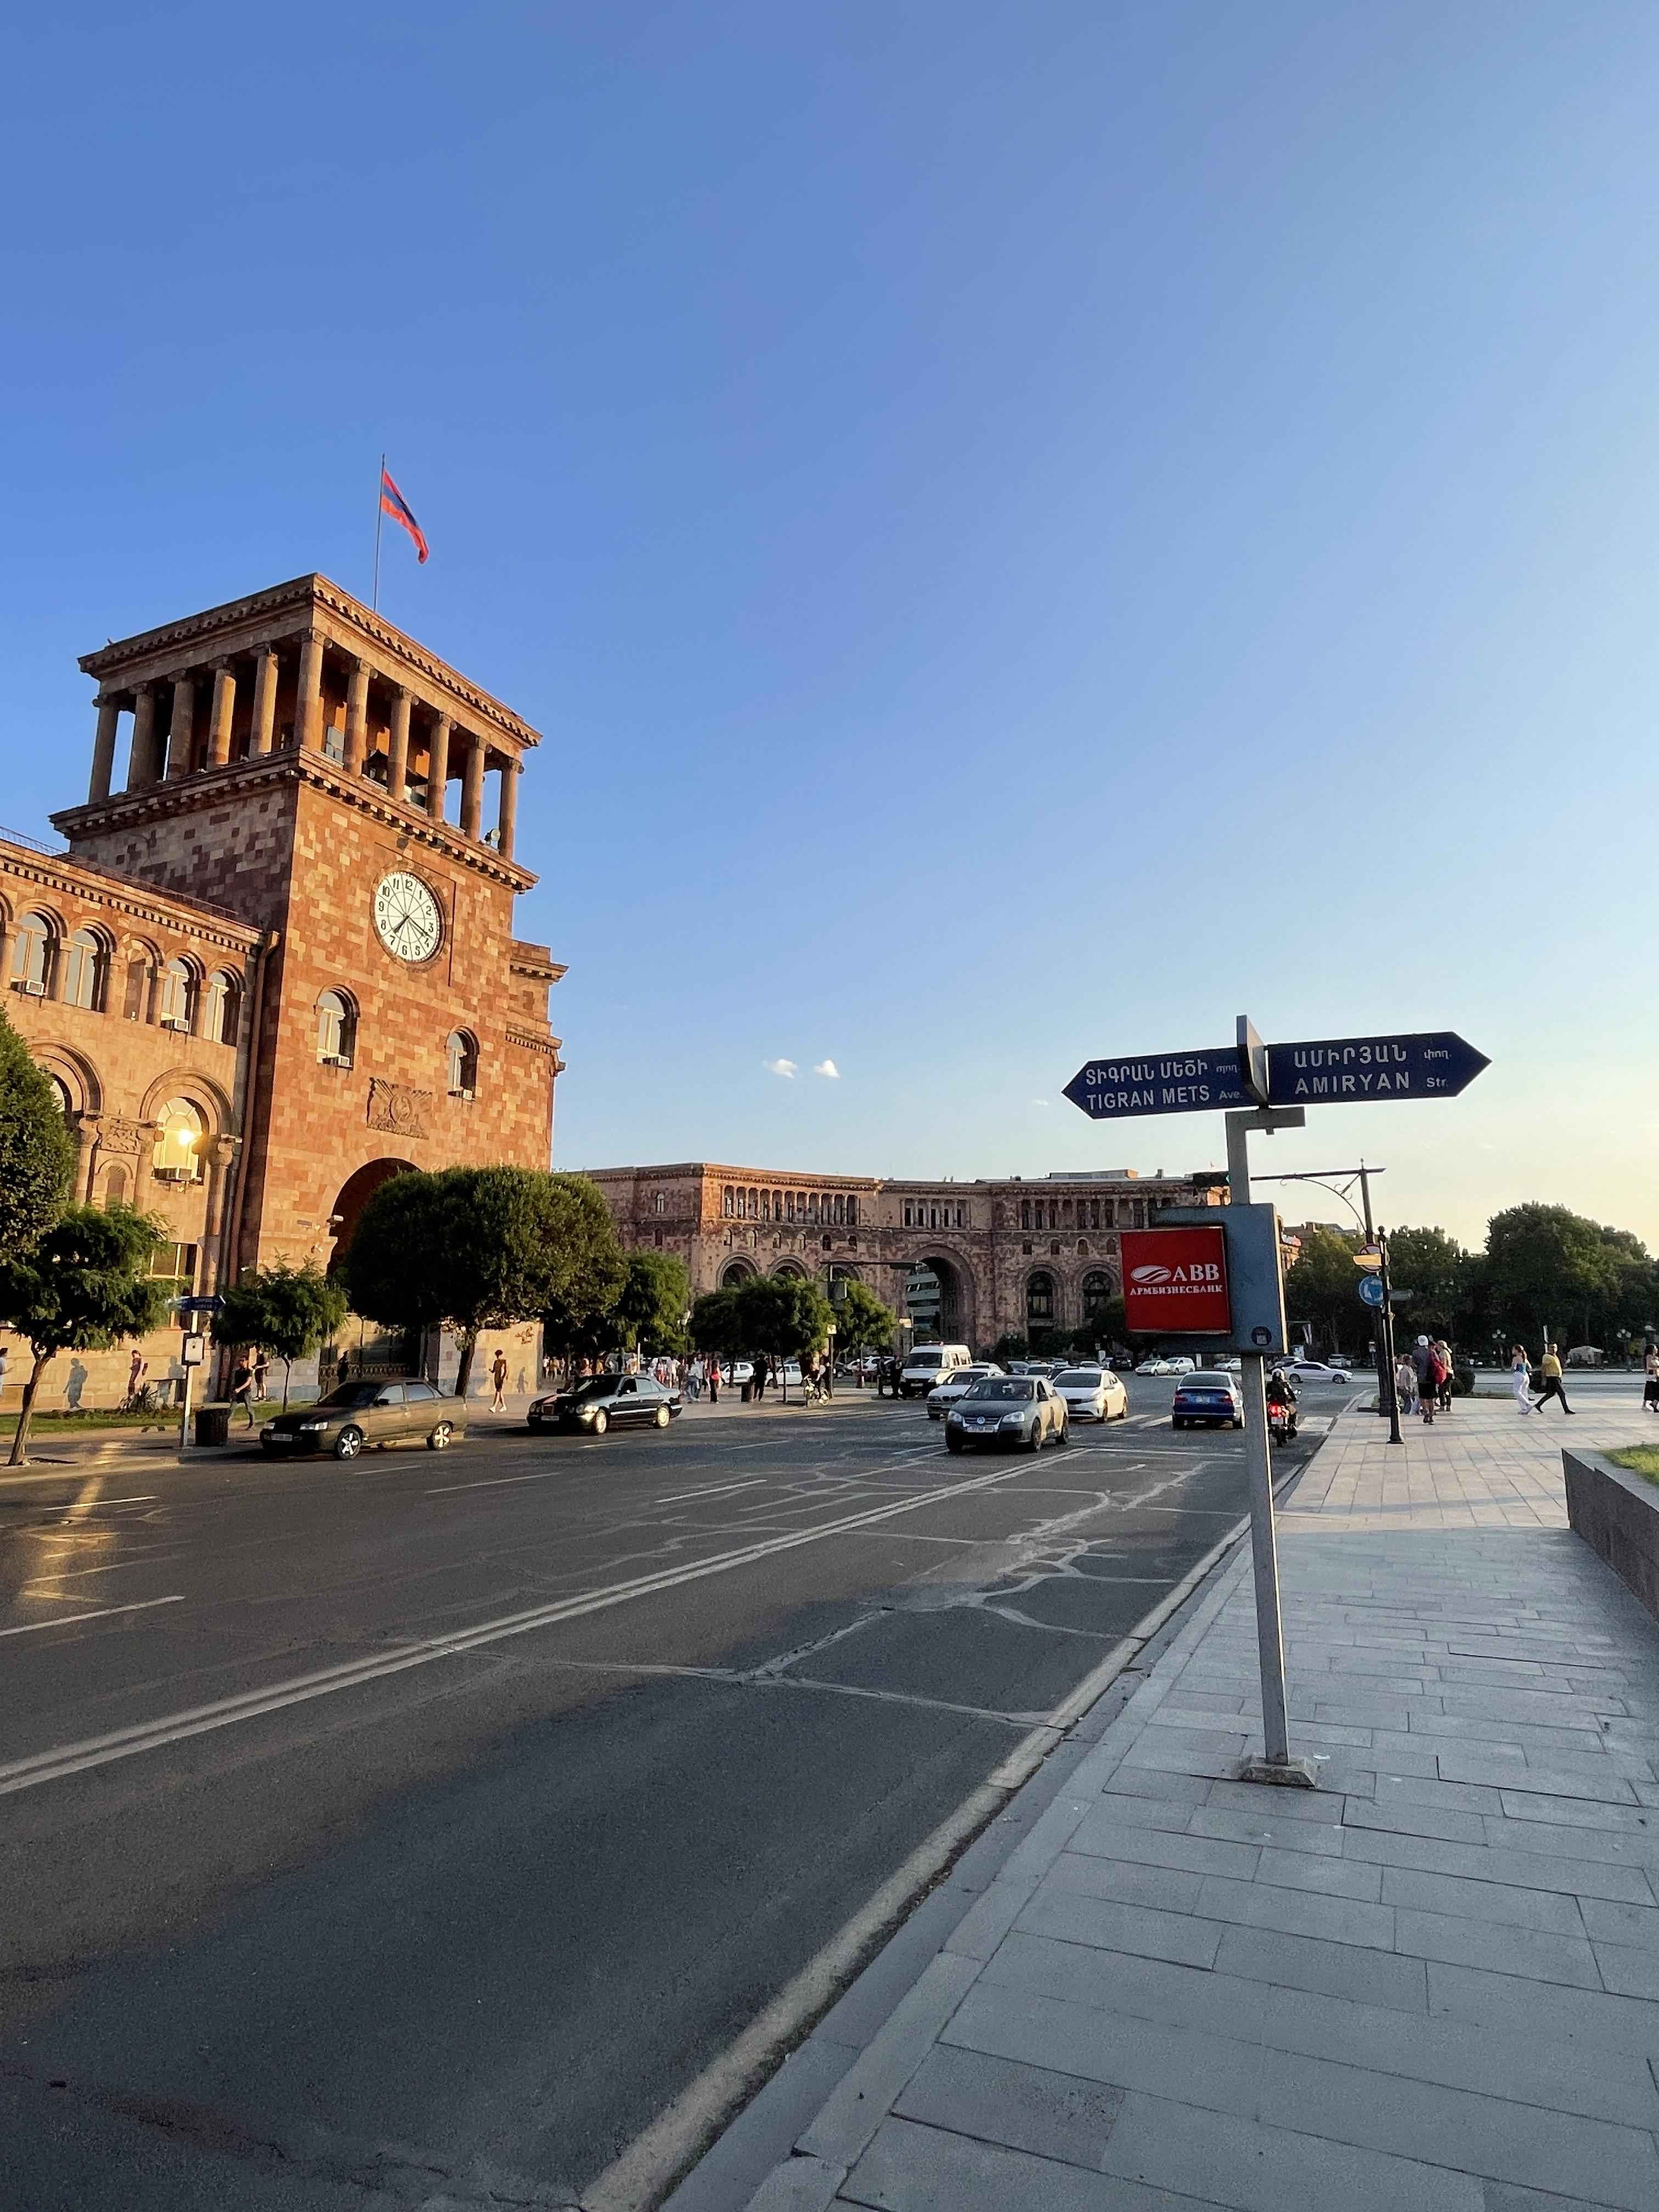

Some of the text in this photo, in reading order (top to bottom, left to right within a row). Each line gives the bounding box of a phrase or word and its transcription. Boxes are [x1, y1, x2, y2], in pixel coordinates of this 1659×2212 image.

[393, 878, 399, 889] 11
[405, 879, 413, 890] 12
[382, 885, 390, 897] 10
[379, 901, 384, 912] 9
[426, 905, 431, 916] 2
[381, 919, 386, 930] 8
[428, 922, 433, 933] 3
[390, 935, 396, 945] 7
[402, 945, 407, 955] 6
[415, 945, 420, 956] 5
[1295, 1045, 1406, 1068] ԱՄԻՐՅԱՆ
[1086, 1064, 1154, 1085] ՏԻԳՐԱՆ
[1160, 1059, 1207, 1079] ՄԵԾԻ
[1295, 1071, 1409, 1094] AMIRYAN
[1086, 1090, 1154, 1110] TIGRAN
[1163, 1085, 1210, 1104] METS
[1172, 1263, 1220, 1282] ABB
[1130, 1284, 1223, 1296] АРМБИЗНЕСБАНК
